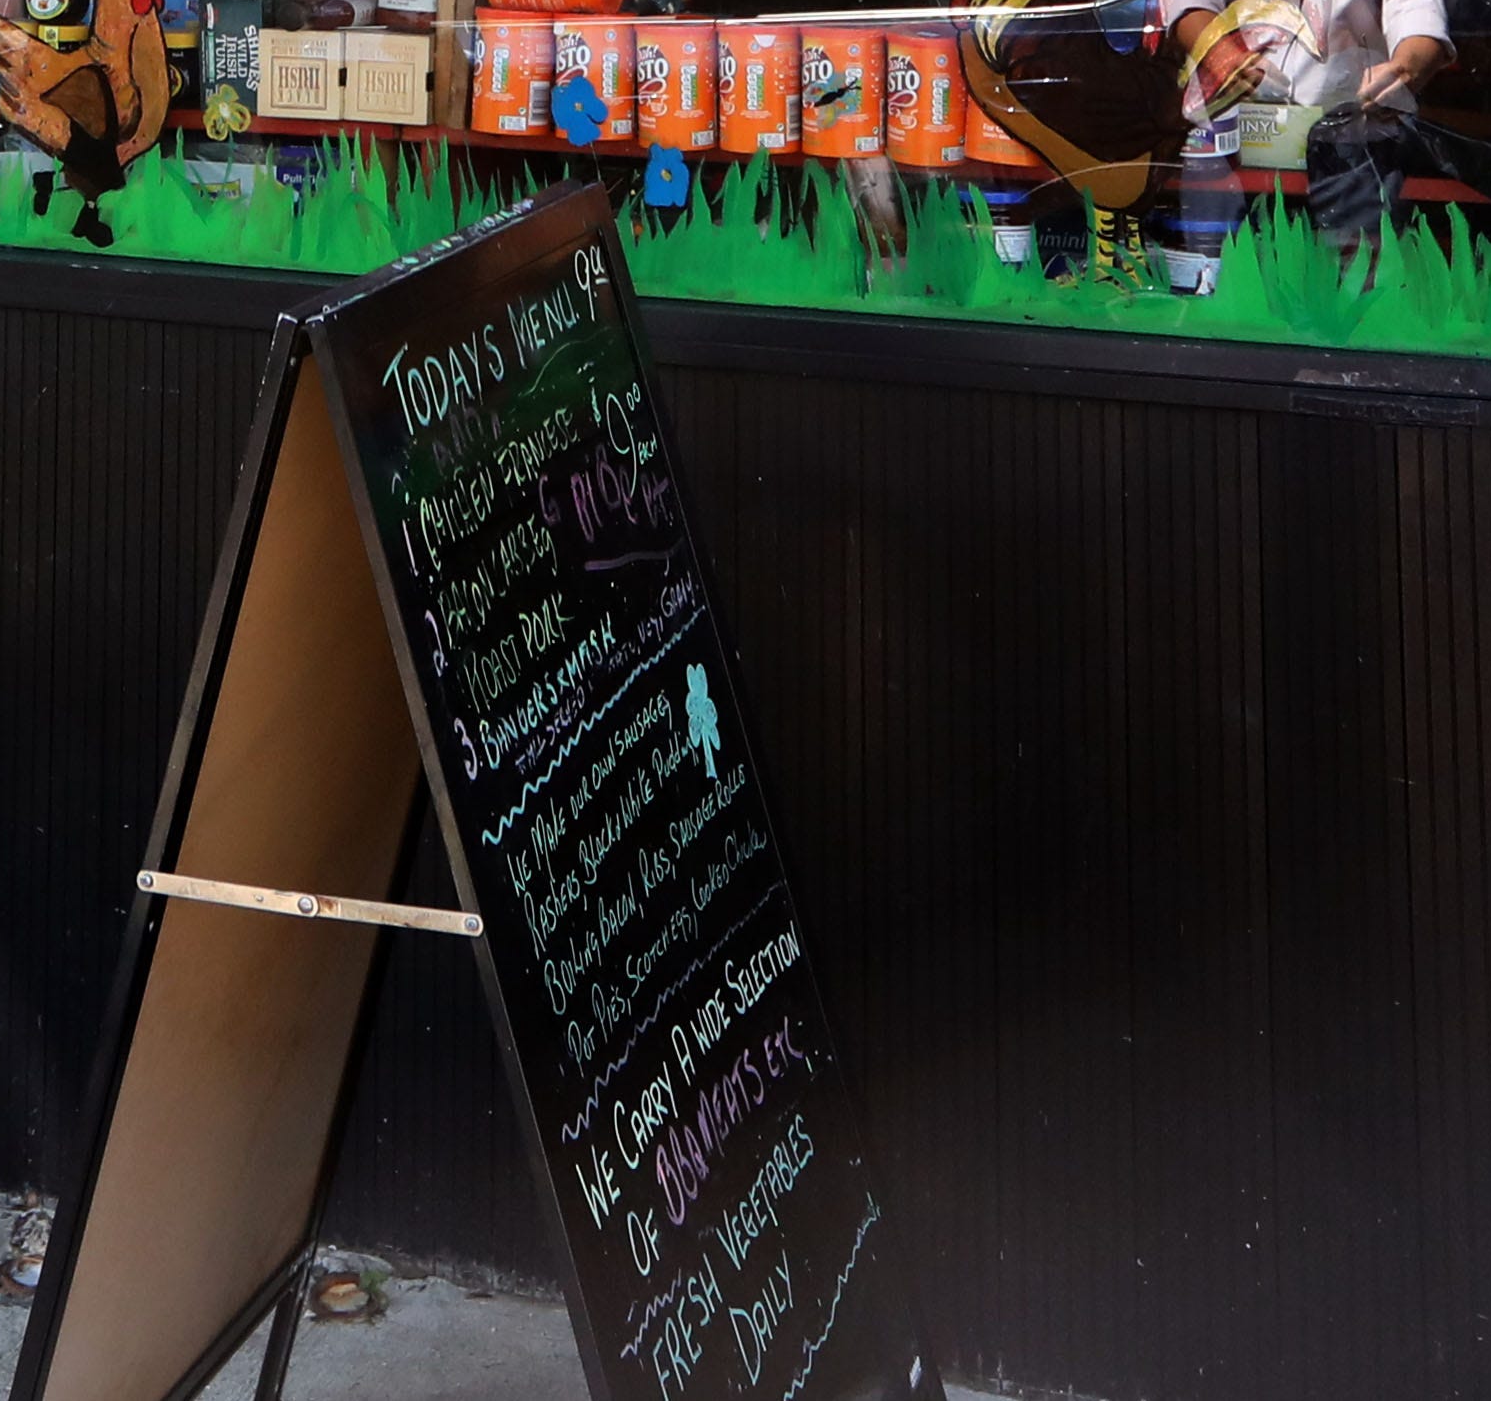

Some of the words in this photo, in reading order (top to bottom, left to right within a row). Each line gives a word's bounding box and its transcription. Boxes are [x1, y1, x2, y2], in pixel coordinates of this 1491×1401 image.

[217, 33, 226, 80] TUNA
[226, 34, 236, 80] IRISH
[237, 37, 247, 79] WILD
[245, 24, 259, 92] SHINES
[383, 324, 505, 435] TODAYS
[725, 921, 801, 1015] SELECTION
